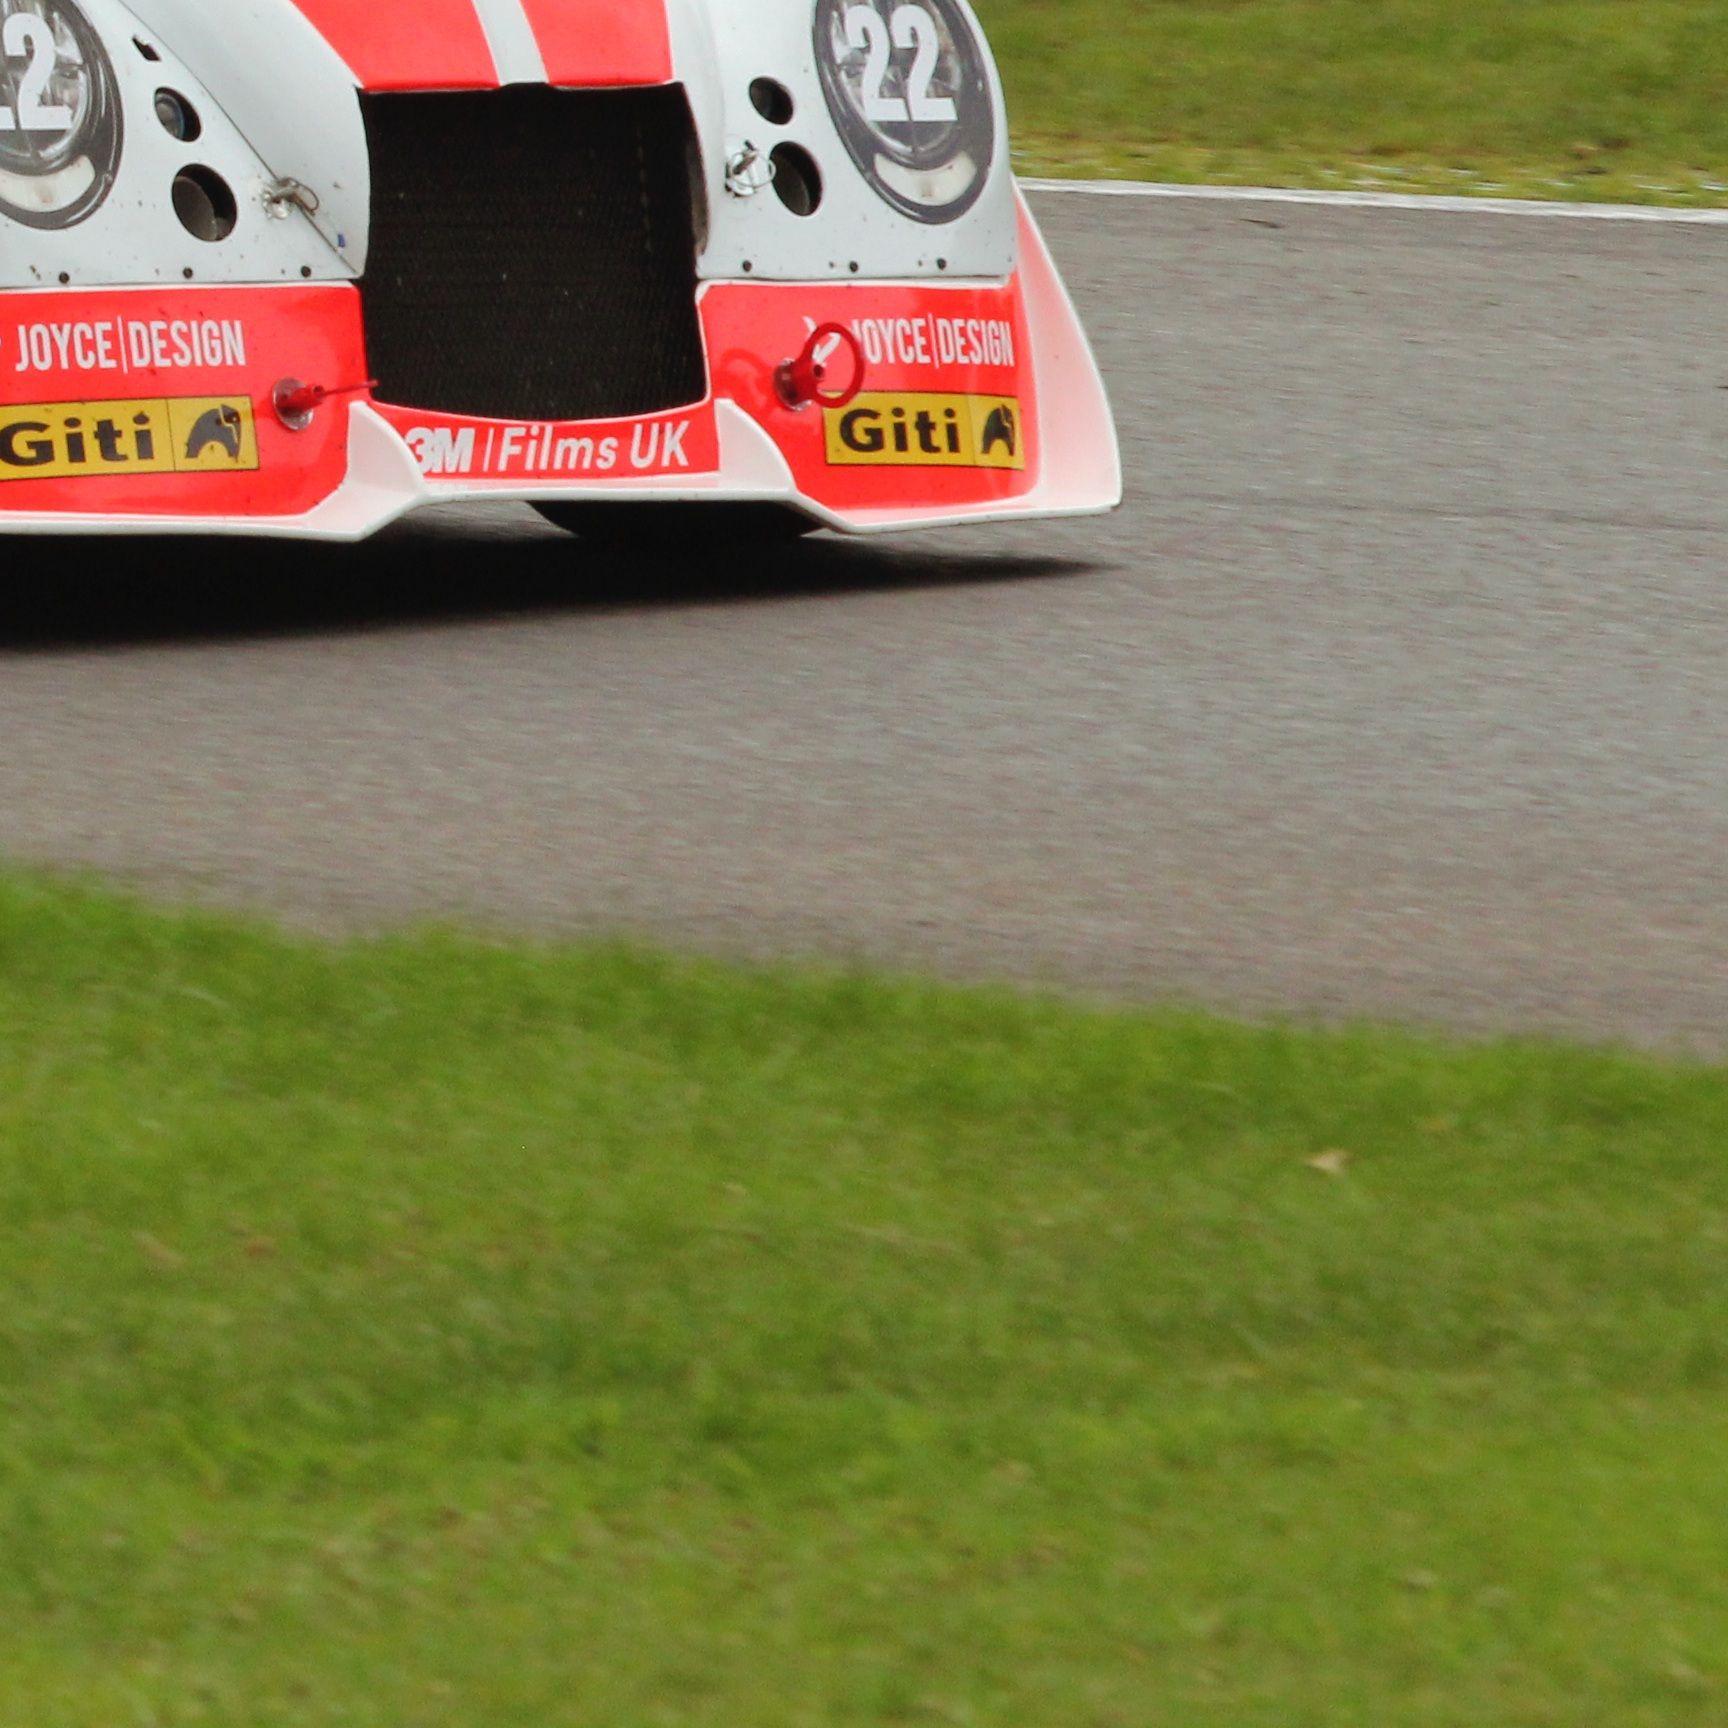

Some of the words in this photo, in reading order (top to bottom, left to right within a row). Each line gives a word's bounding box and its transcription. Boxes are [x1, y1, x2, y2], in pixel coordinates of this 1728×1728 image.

[845, 4, 959, 122] 22
[15, 322, 117, 372] JOYCE
[128, 319, 246, 369] DESIGN
[939, 317, 1015, 367] DESIGN
[402, 427, 476, 474] 3M
[497, 424, 620, 472] Films
[629, 419, 692, 469] UK
[839, 407, 961, 454] Giti
